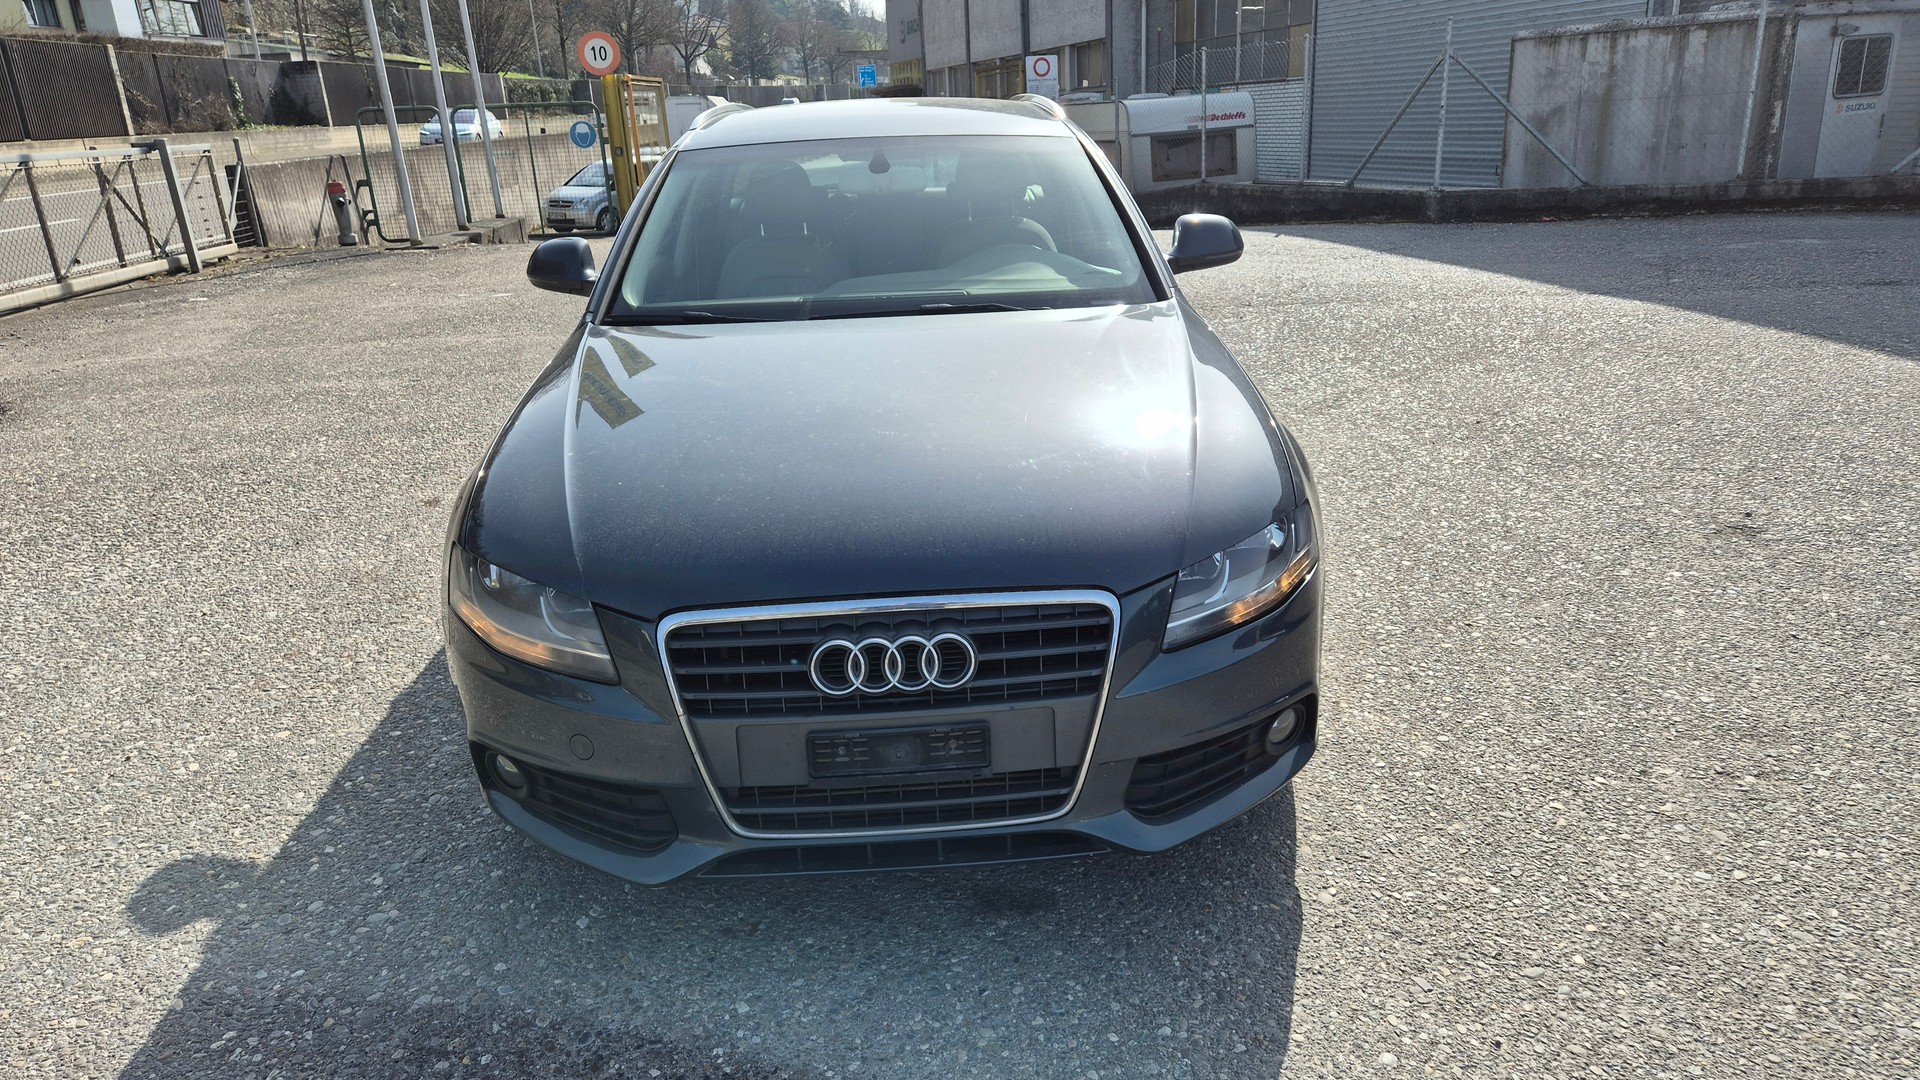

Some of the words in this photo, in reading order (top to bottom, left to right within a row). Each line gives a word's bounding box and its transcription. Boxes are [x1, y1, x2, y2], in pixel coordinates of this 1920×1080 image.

[590, 45, 608, 61] 10
[1845, 102, 1877, 112] SUZUKI
[1210, 111, 1246, 122] Dethleffs
